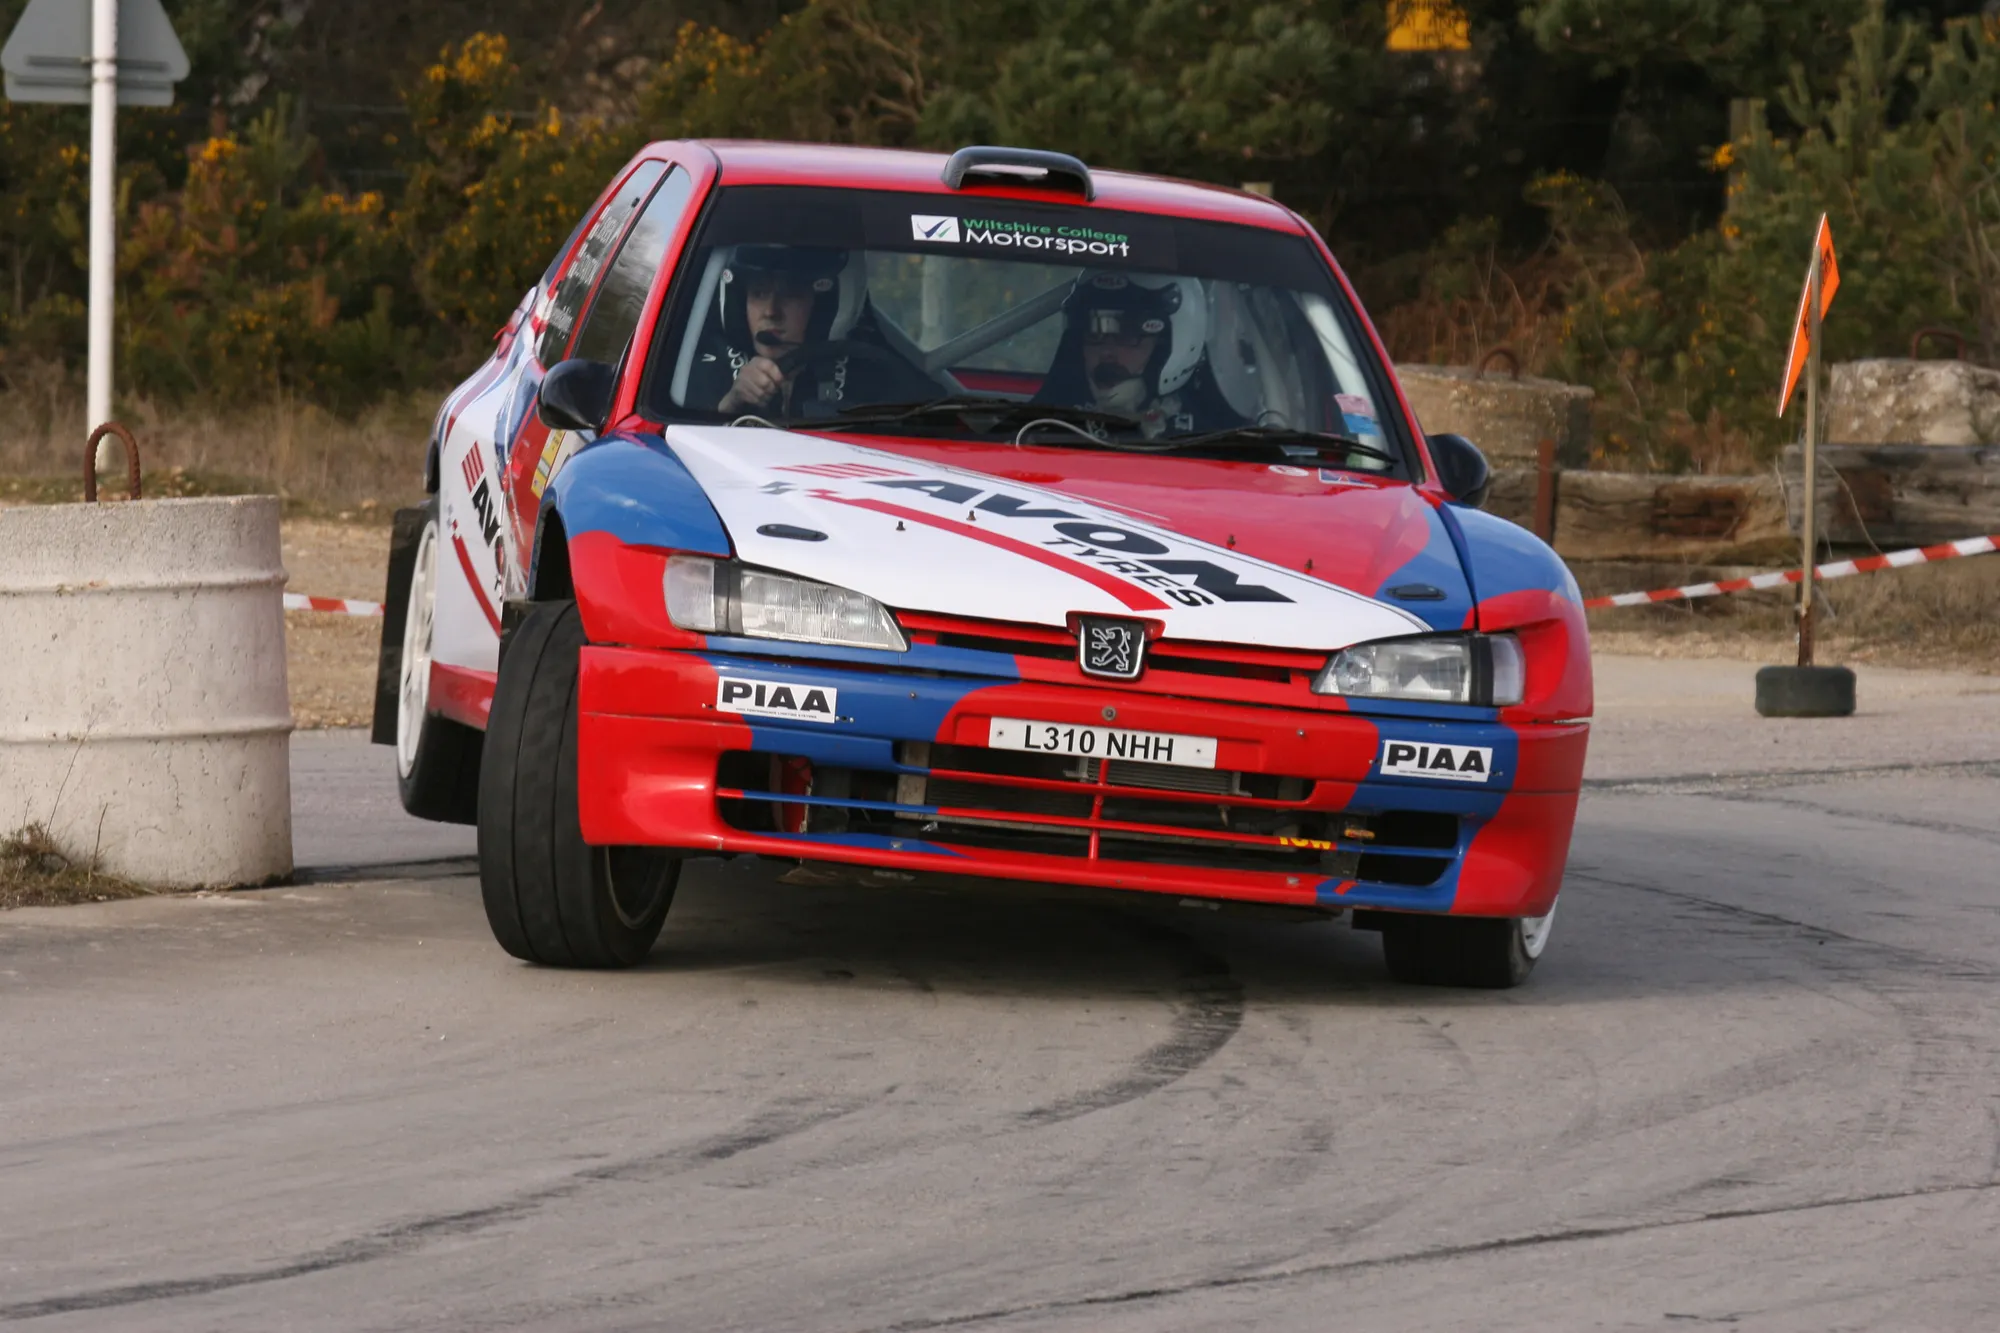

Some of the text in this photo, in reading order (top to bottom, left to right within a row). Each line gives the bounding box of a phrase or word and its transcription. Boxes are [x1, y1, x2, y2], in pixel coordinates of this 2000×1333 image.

[963, 218, 1128, 243] Wiltshire College
[965, 228, 1130, 257] Motorsport
[861, 480, 1297, 604] AVON
[1041, 537, 1215, 607] TYRES
[721, 680, 831, 714] PIAA
[1024, 725, 1174, 762] L310 NHH
[1387, 743, 1485, 773] PIAA
